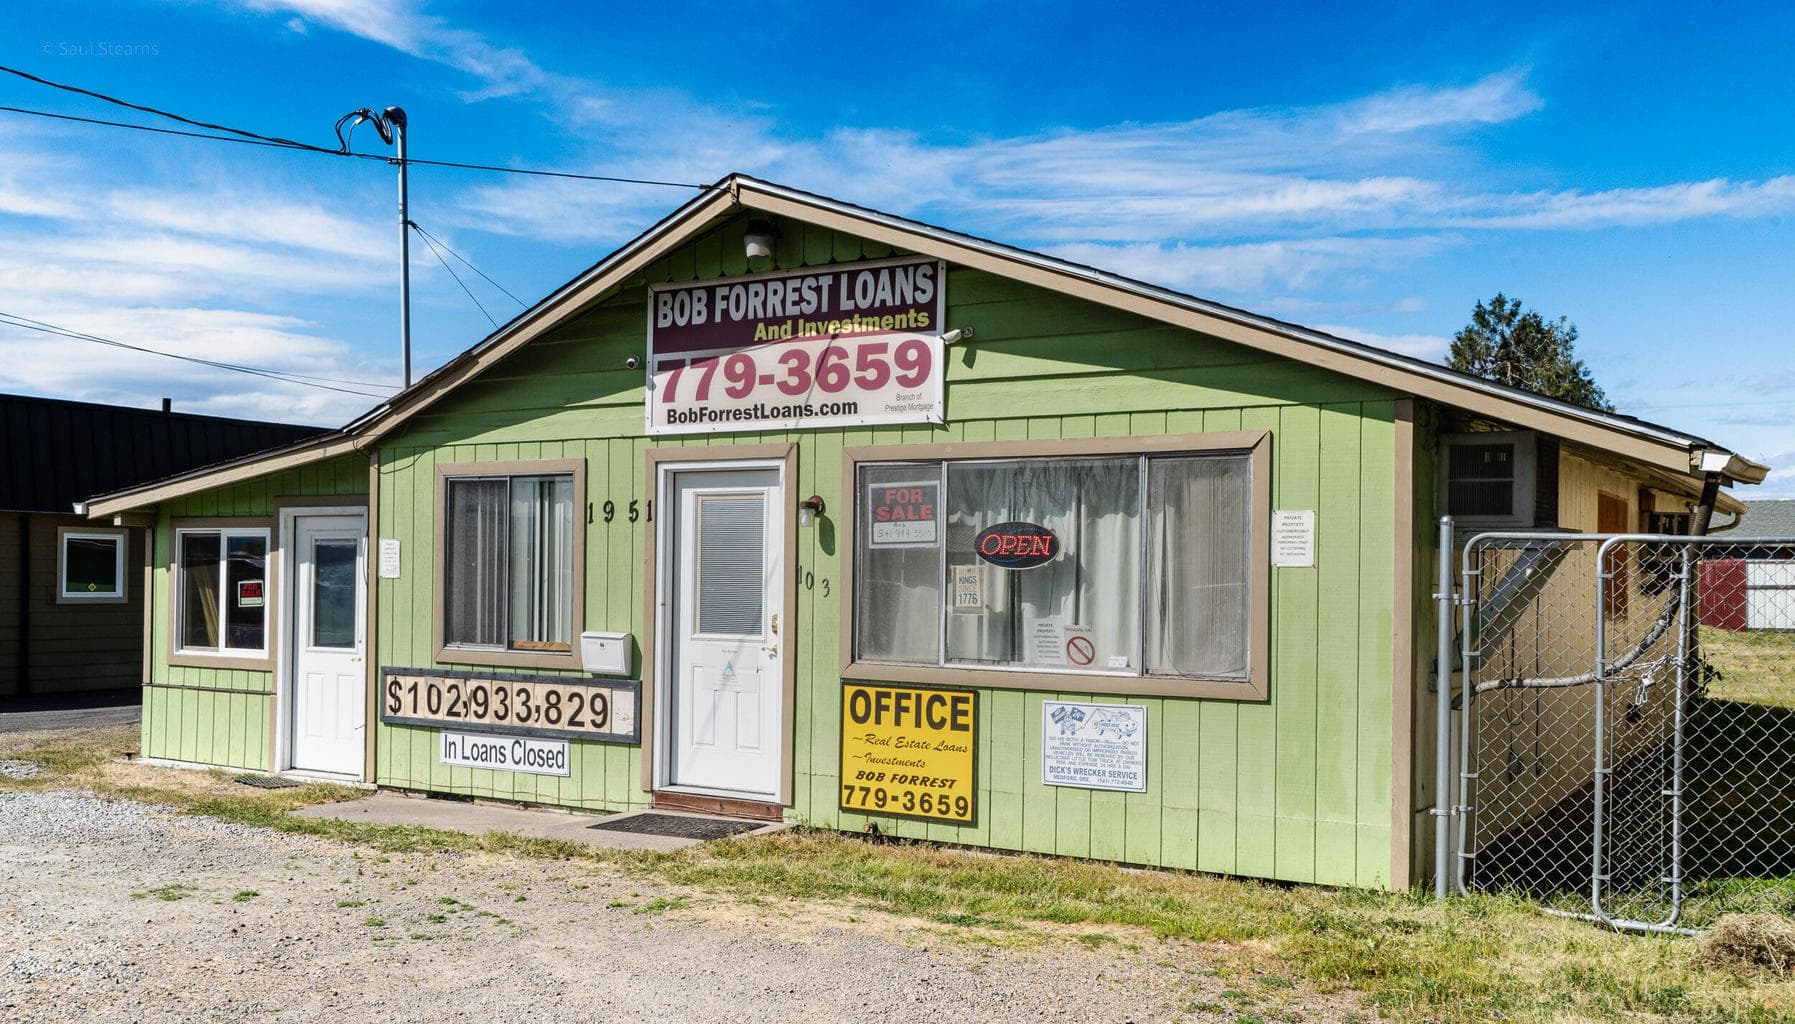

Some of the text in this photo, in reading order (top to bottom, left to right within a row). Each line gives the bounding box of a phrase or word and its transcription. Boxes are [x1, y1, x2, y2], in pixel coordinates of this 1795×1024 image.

[657, 264, 934, 328] BOB FORREST LOANS
[754, 309, 930, 341] And Investments
[657, 339, 932, 403] 779-3659
[885, 403, 933, 413] Prestige Mortgage
[896, 393, 915, 401] Branch
[666, 401, 858, 425] BobForrestLoans.com
[885, 488, 923, 505] FOR
[588, 500, 652, 524] 1951
[876, 504, 933, 521] SALE
[981, 532, 1052, 556] OPEN
[959, 575, 977, 584] KINGS
[959, 592, 977, 605] 1776
[388, 676, 609, 729] $102,933,829
[849, 689, 970, 732] OFFICE
[444, 734, 565, 770] In Loans Closed
[895, 737, 931, 750] Estate
[932, 741, 968, 753] Loans
[855, 770, 957, 789] BOB FORREST
[1049, 765, 1137, 779] DICK'S WRECKER SERVICE
[843, 784, 969, 818] 779-3659
